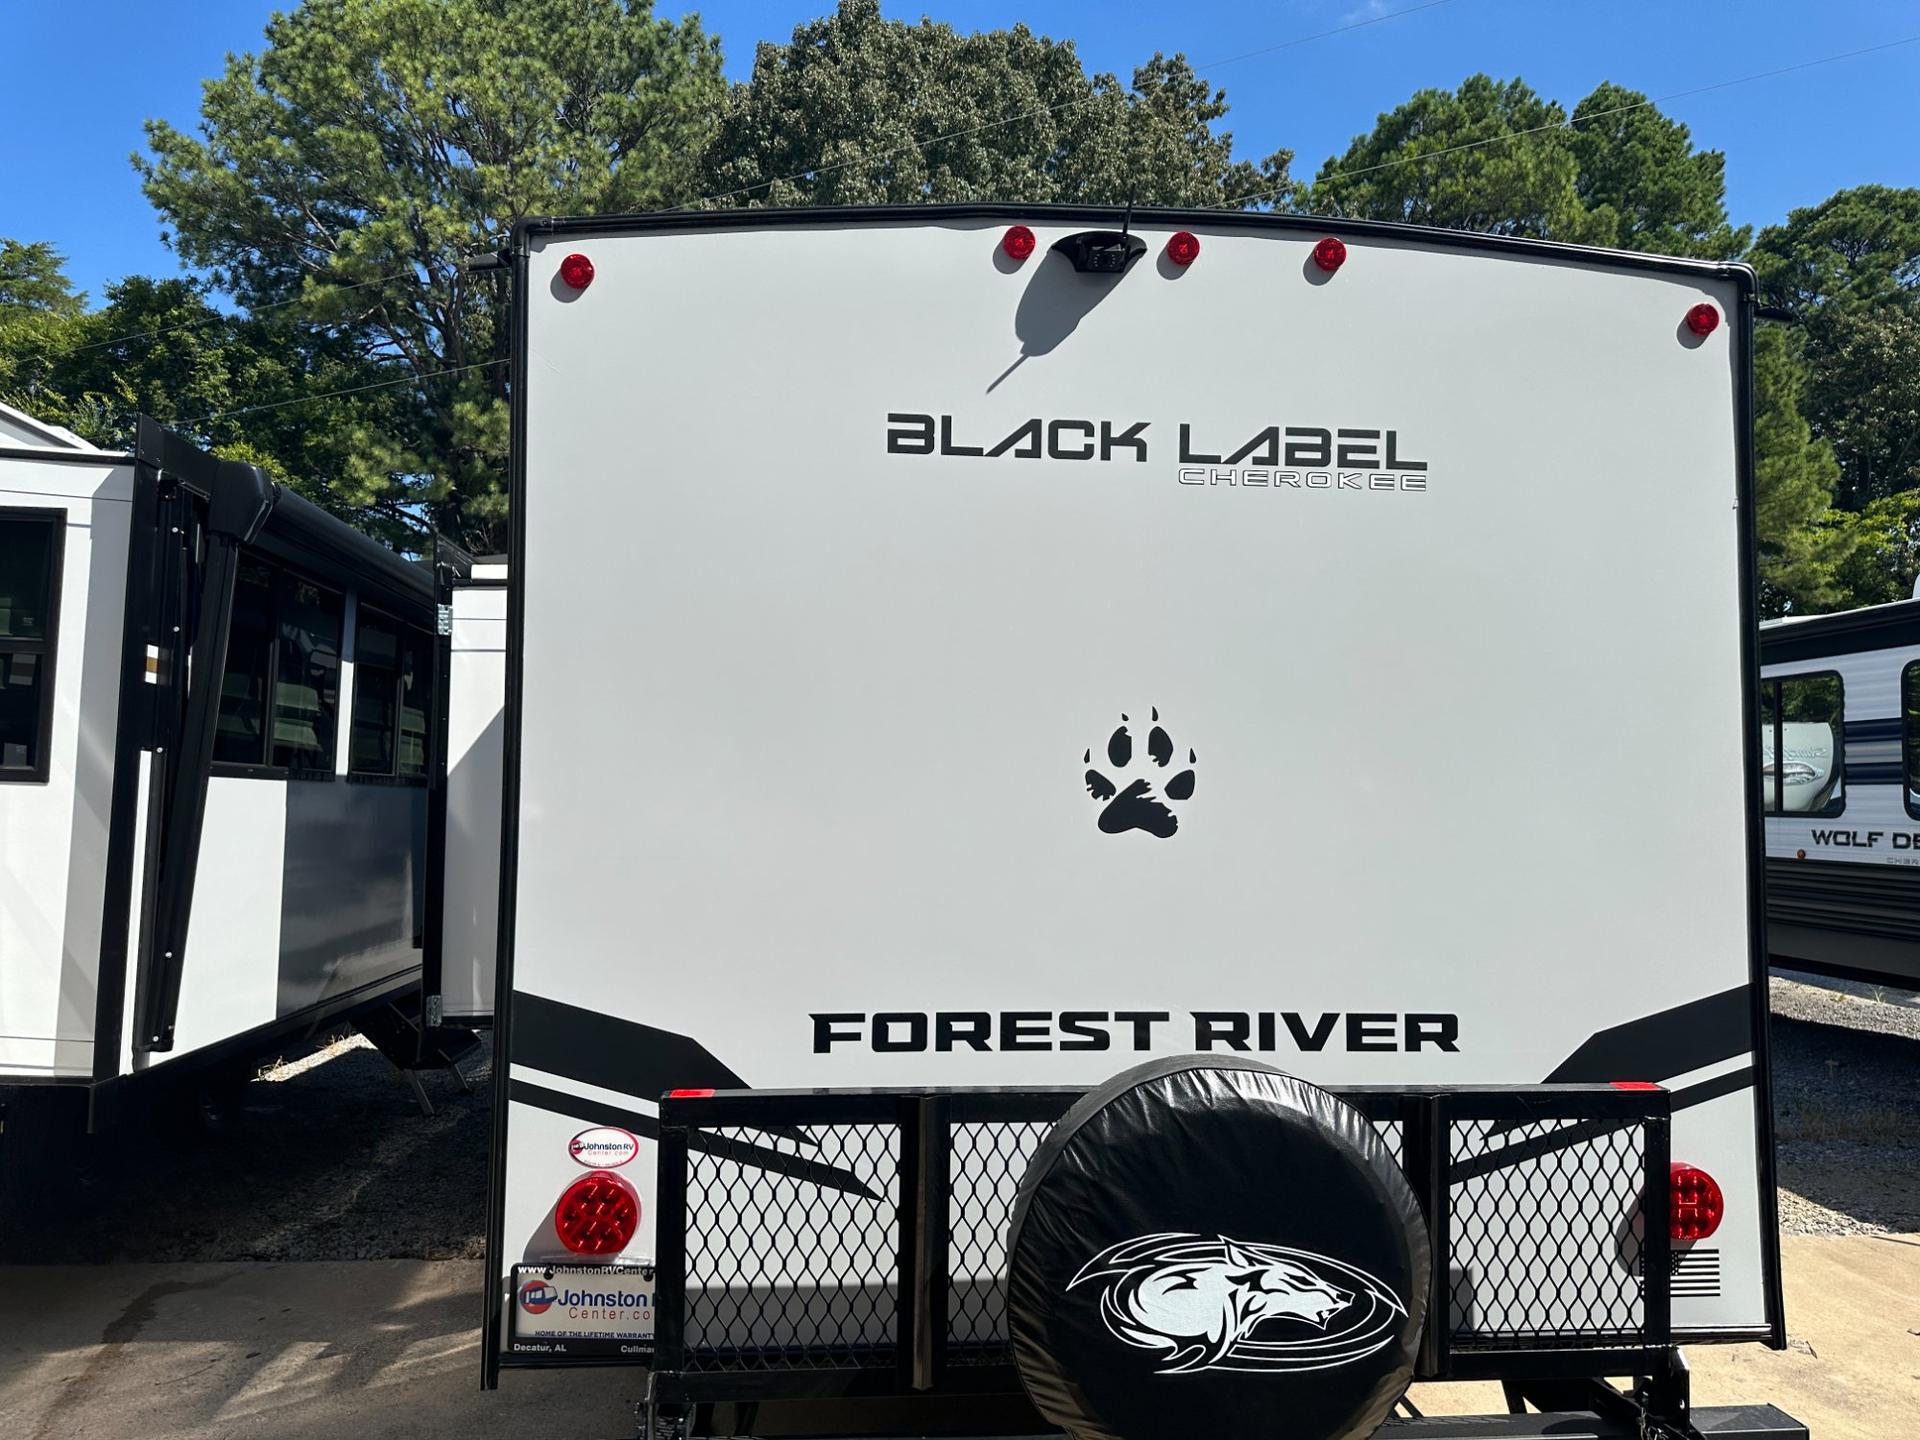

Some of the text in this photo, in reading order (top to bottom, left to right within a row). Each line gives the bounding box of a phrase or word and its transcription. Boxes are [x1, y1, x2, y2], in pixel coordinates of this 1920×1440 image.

[887, 413, 1428, 471] BLACK LABEL
[1178, 468, 1427, 492] CHEROKEE
[1811, 829, 1884, 848] WOLF
[808, 1011, 1461, 1054] FOREST RIVER
[586, 1142, 622, 1150] Johnston
[558, 1289, 648, 1307] Johnston
[513, 1343, 567, 1352] Decatur, AL
